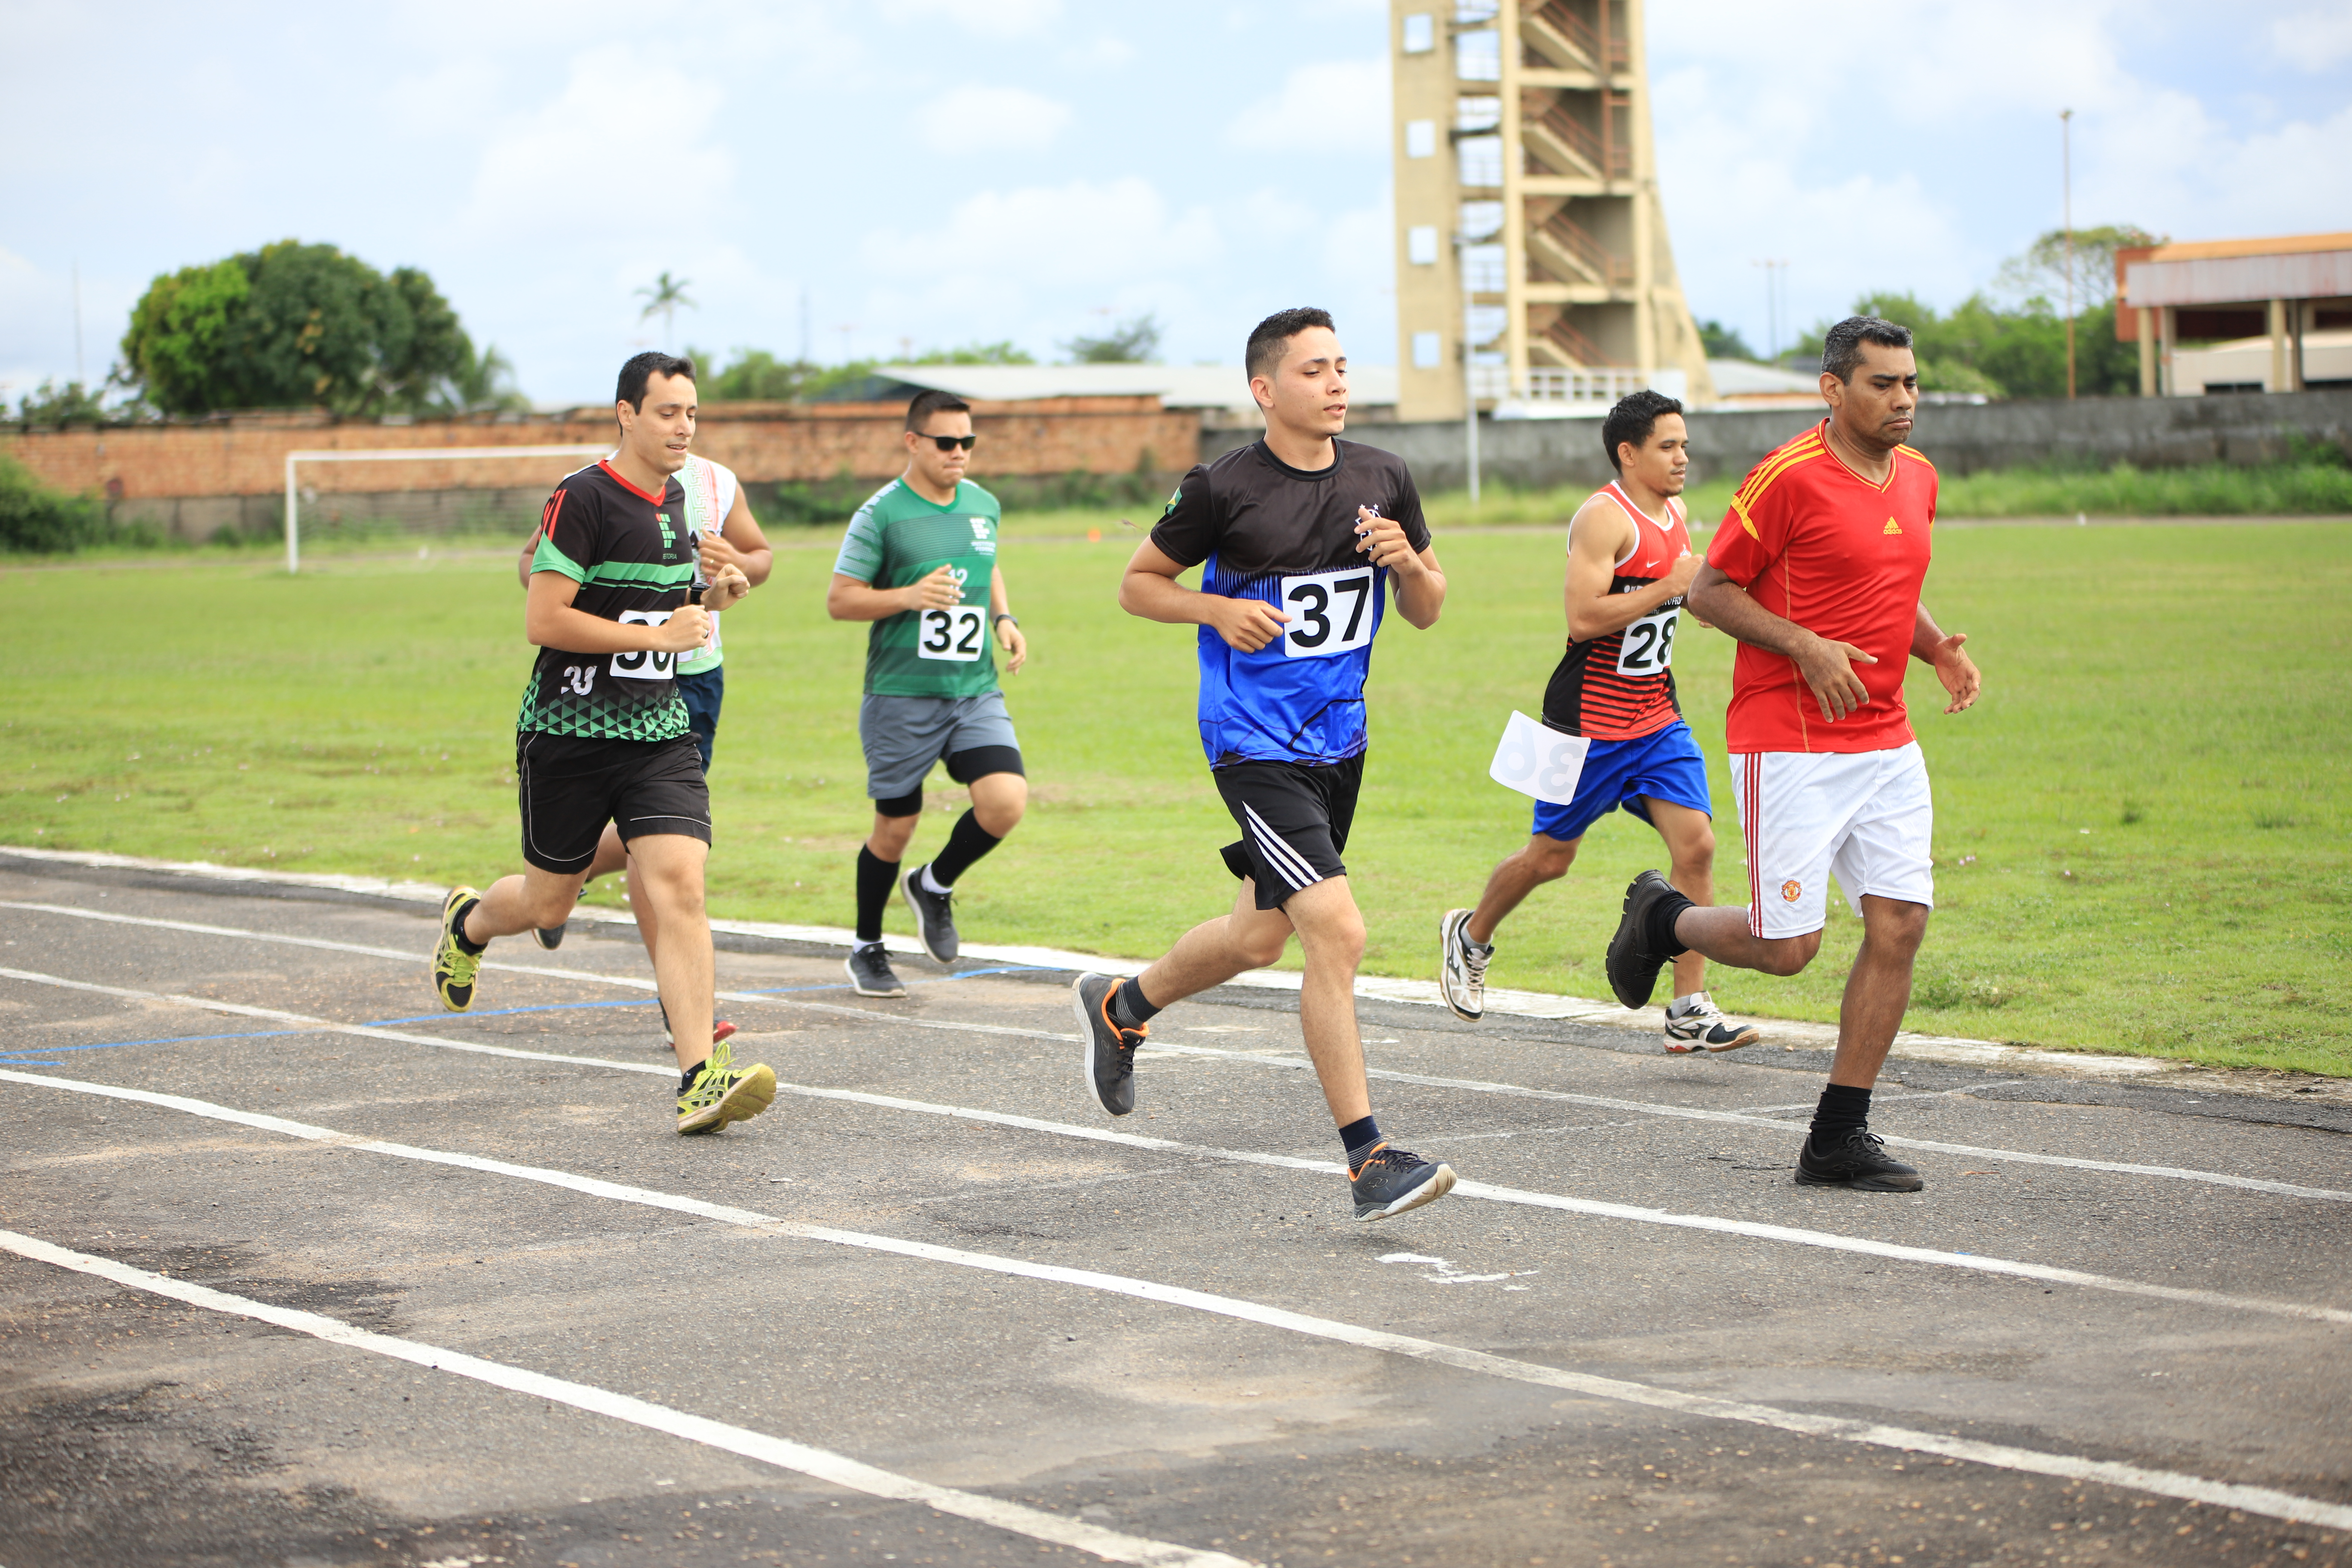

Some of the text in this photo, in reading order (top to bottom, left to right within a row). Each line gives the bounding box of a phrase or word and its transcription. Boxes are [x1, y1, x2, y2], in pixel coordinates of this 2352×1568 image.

[923, 611, 980, 654] 32
[1288, 576, 1370, 648] 37
[1622, 616, 1677, 669] 28
